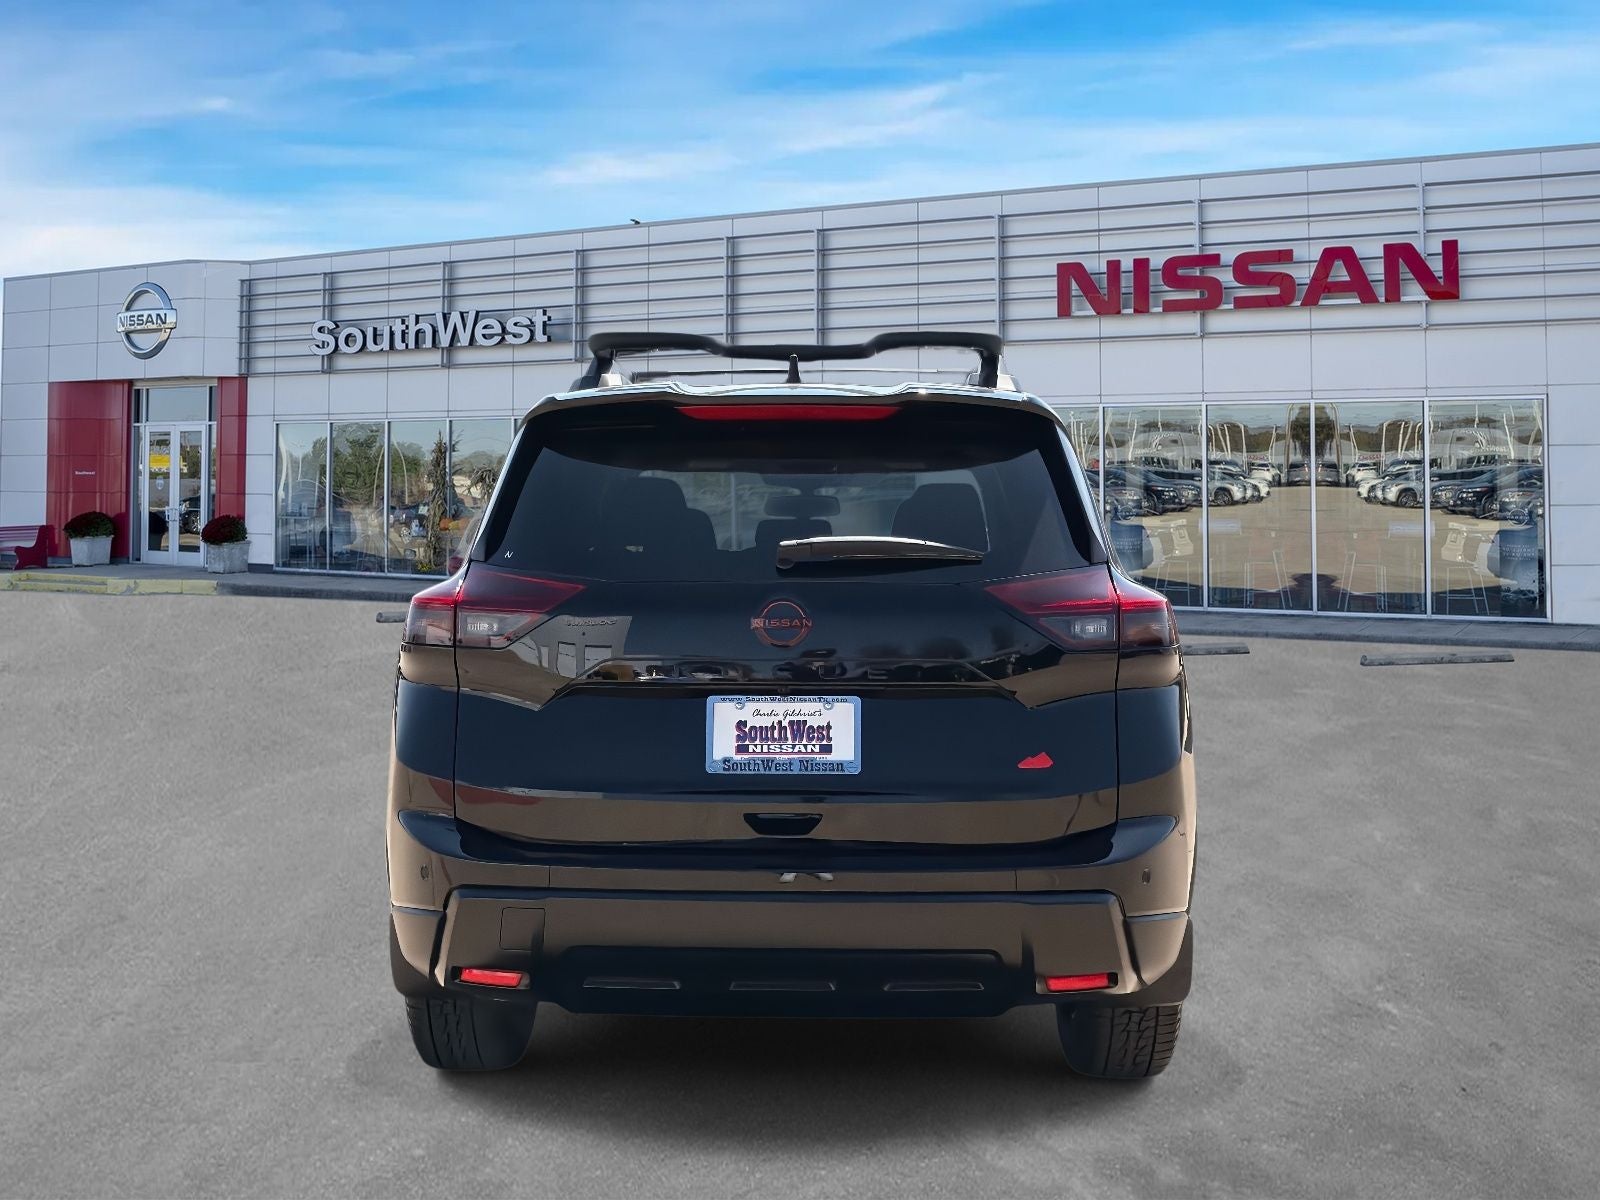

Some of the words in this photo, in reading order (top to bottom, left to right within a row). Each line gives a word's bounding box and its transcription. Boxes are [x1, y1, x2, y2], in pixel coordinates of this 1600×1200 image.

[1057, 240, 1460, 317] NISSAN
[118, 312, 168, 328] NISSAN
[309, 308, 551, 356] SouthWest
[751, 618, 812, 629] NISSAN
[735, 720, 833, 744] SouthWest
[748, 744, 821, 753] NISSAN
[722, 759, 794, 772] SouthWest
[799, 759, 846, 772] Nissan
